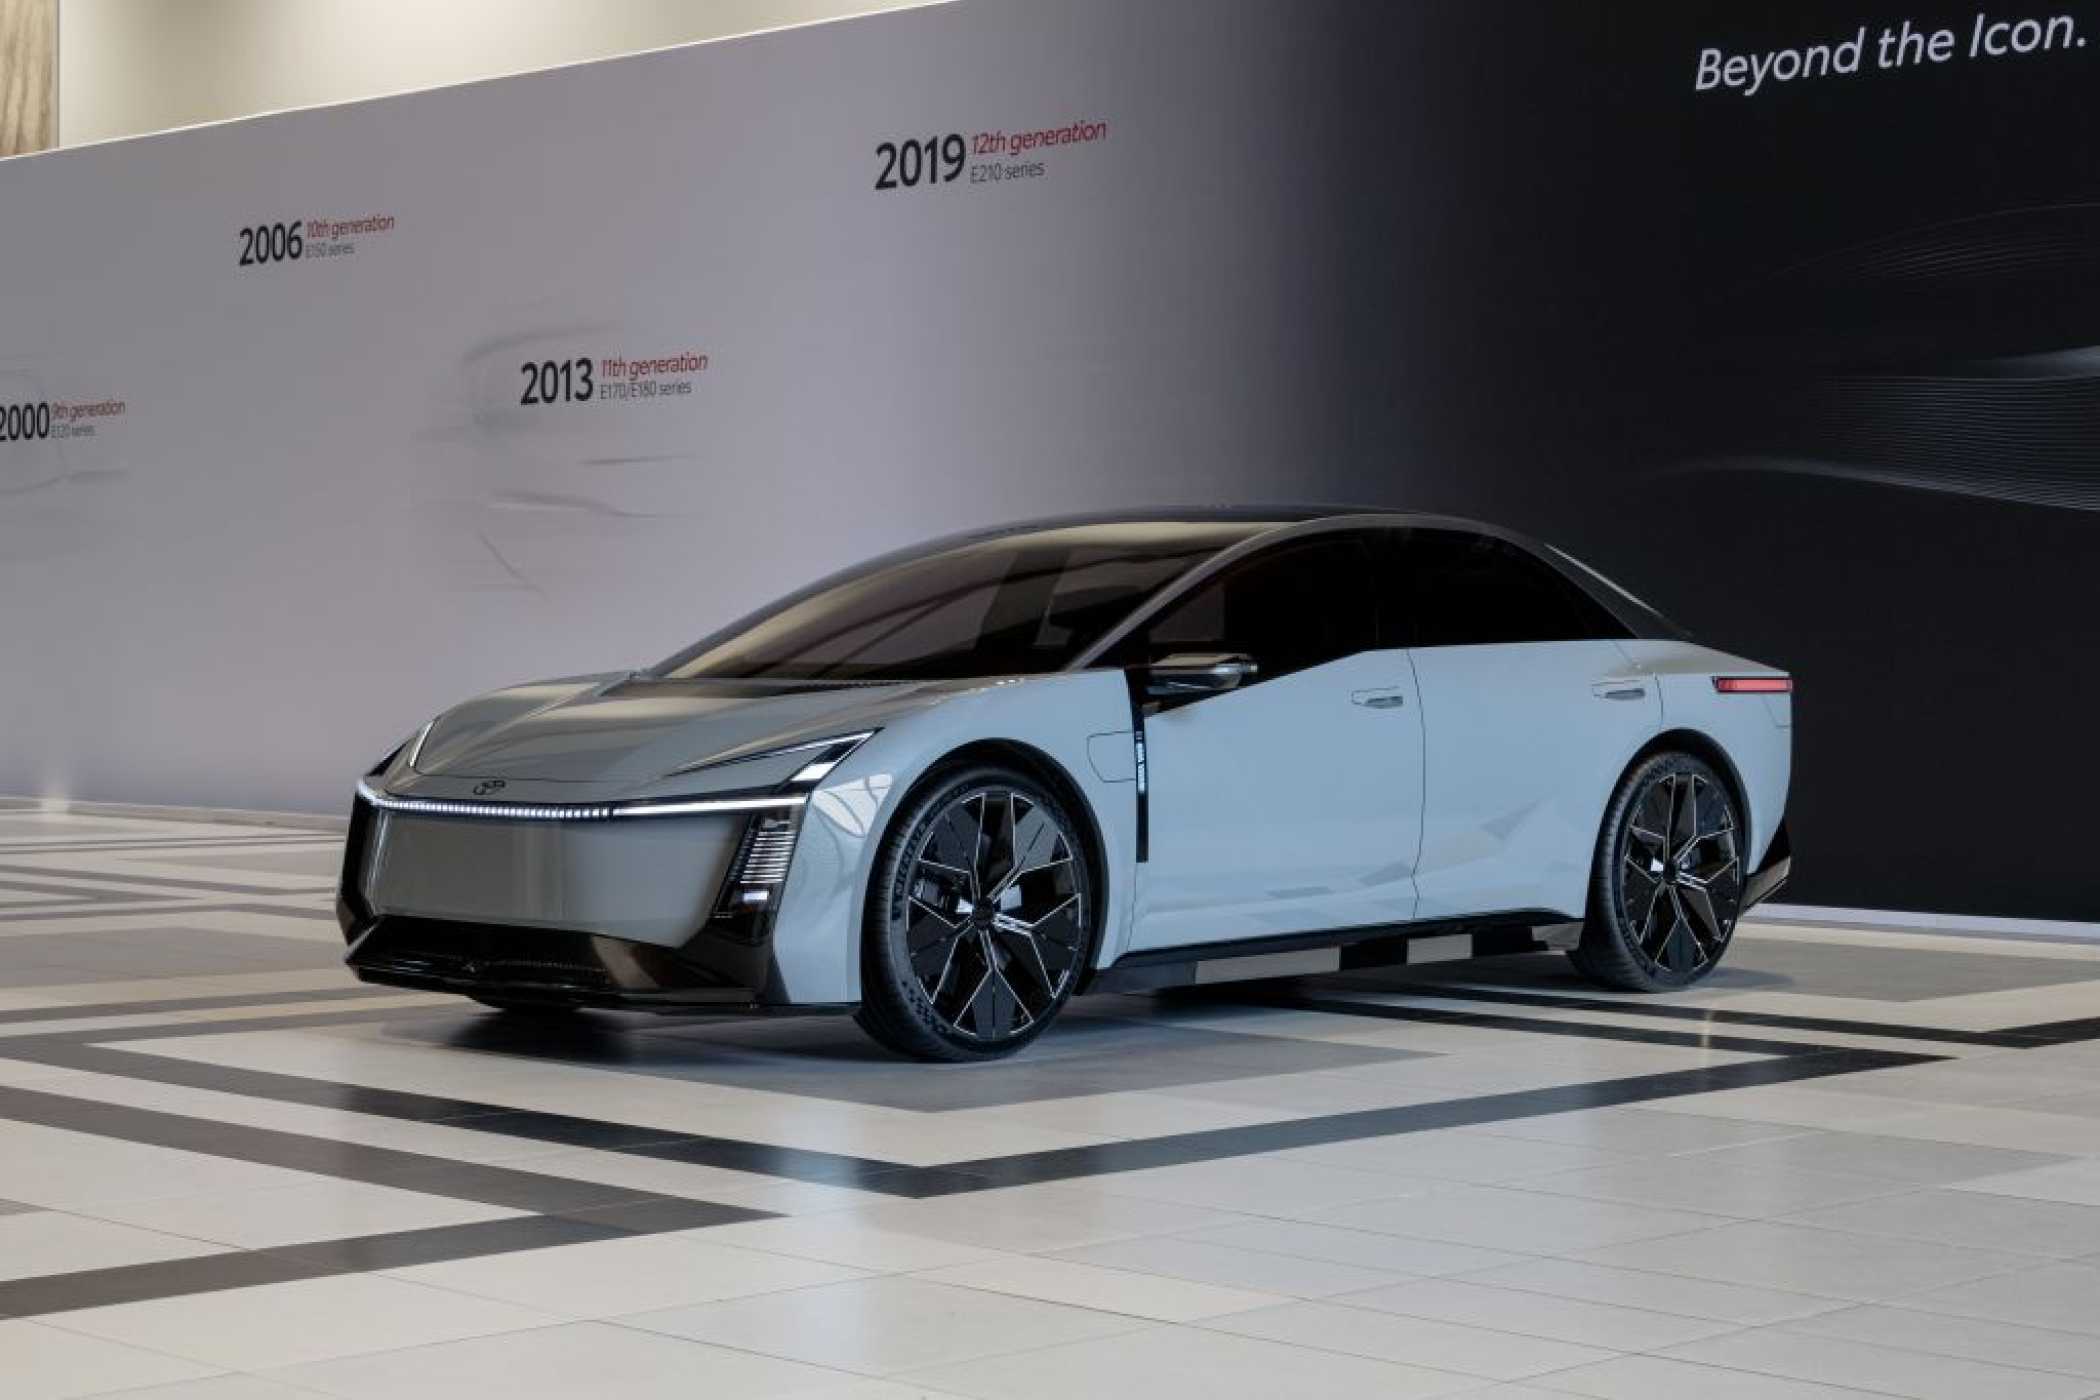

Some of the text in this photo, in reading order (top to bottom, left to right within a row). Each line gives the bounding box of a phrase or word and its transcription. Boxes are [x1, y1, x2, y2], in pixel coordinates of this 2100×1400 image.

[1695, 13, 2087, 96] Beyond the Icon.
[972, 120, 1107, 155] 12th generation
[875, 133, 967, 190] 2019
[970, 160, 1045, 184] E210 series
[239, 220, 302, 266] 2006
[331, 214, 395, 240] generation
[520, 357, 594, 405] 2013
[602, 352, 709, 380] 11th generation
[659, 381, 692, 396] series
